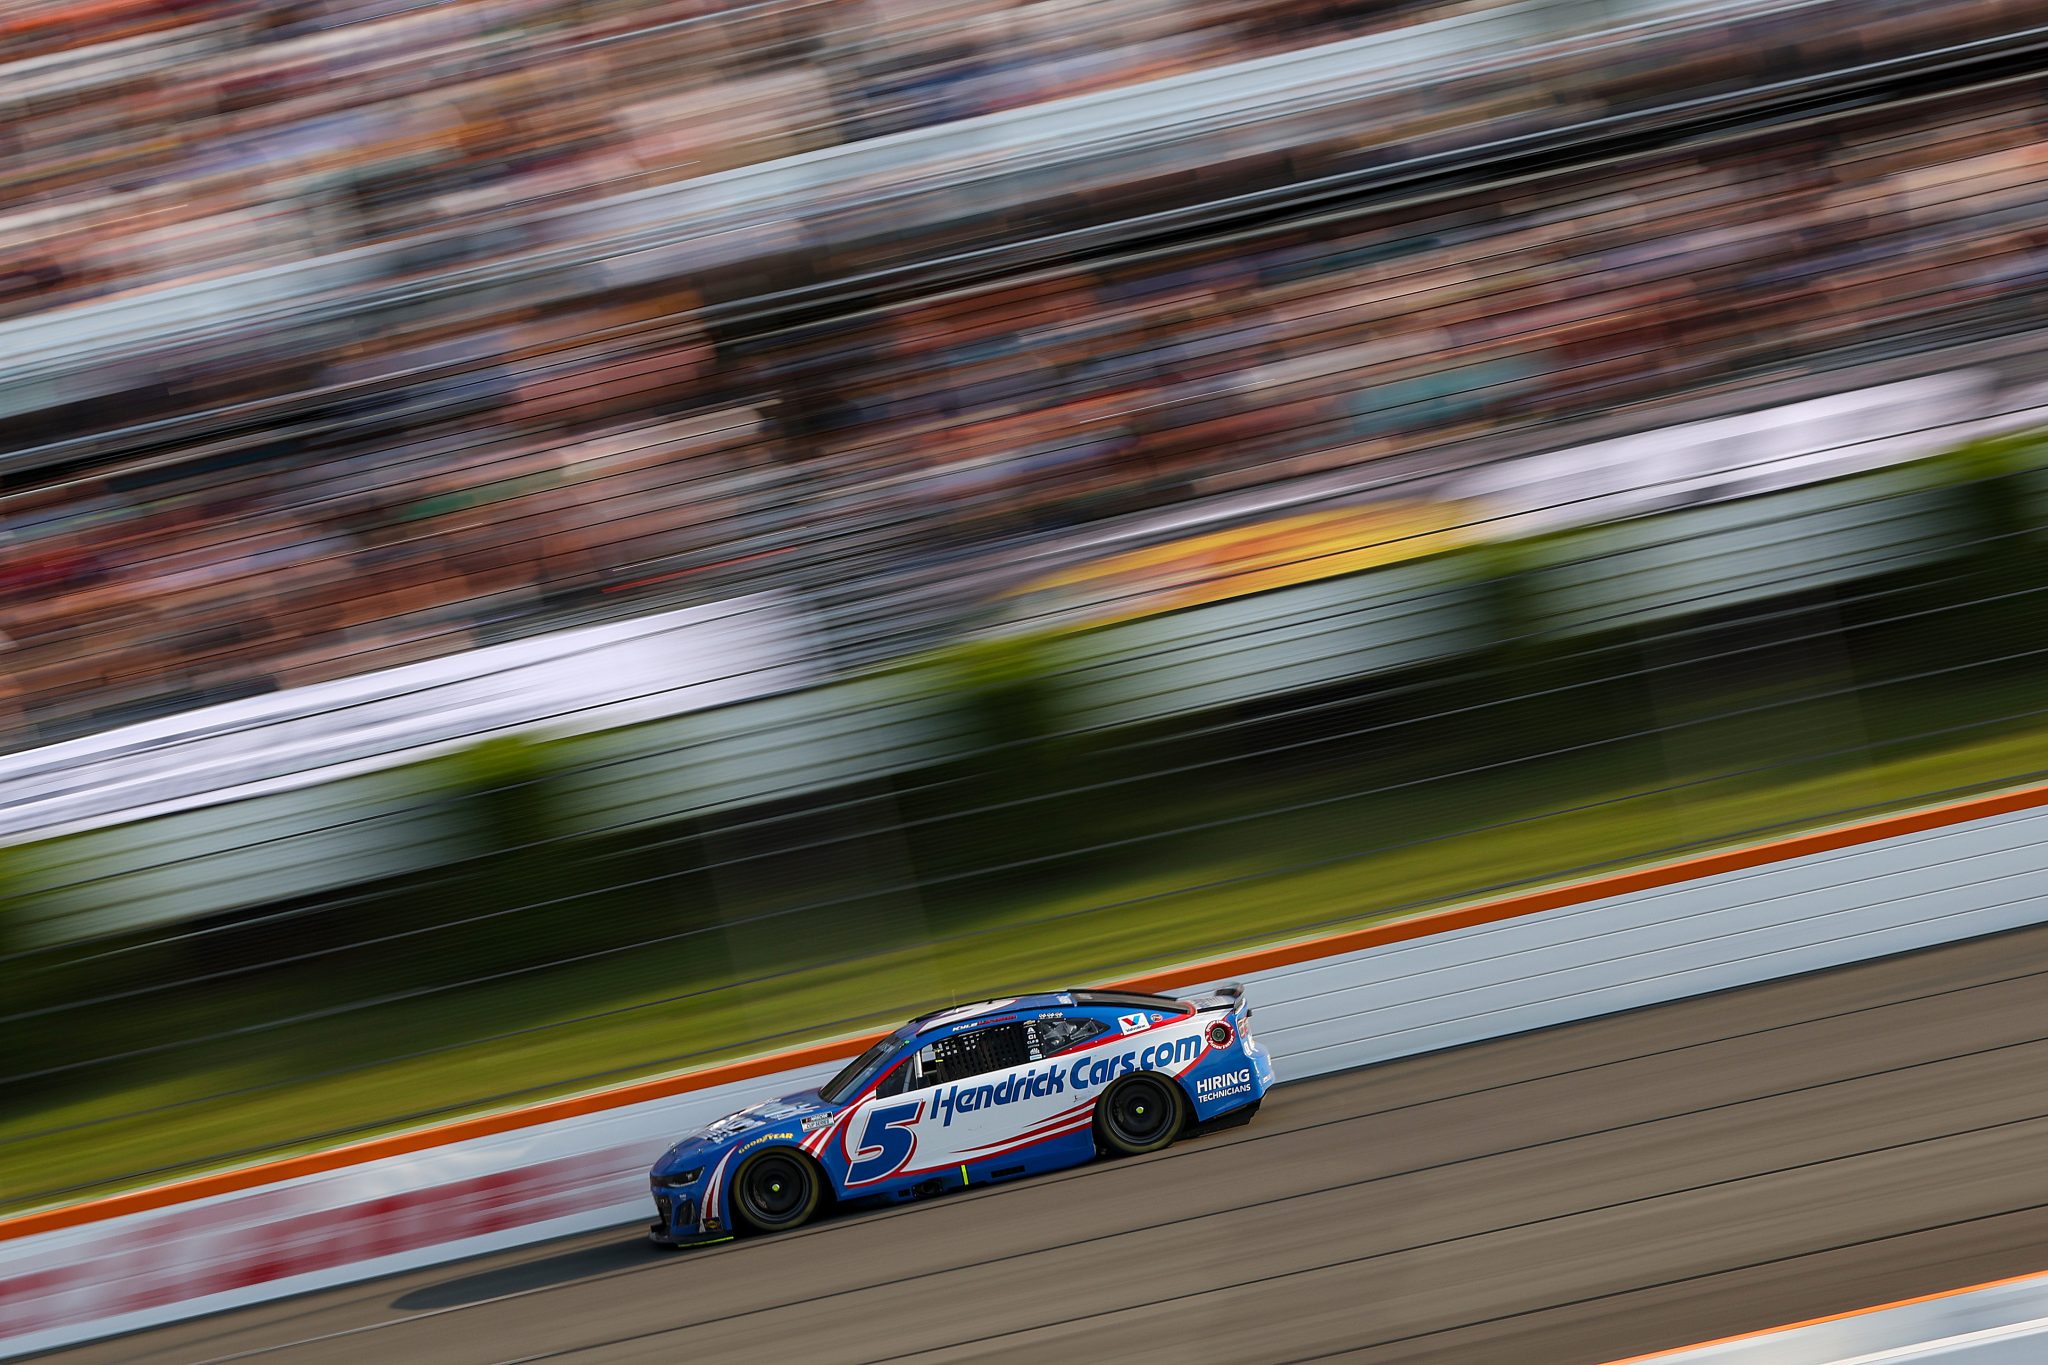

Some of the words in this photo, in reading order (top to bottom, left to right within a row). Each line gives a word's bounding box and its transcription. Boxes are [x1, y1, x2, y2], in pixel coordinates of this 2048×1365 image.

[1196, 1068, 1250, 1094] HIRING
[1198, 1083, 1251, 1103] TECHNICIANS
[738, 1132, 794, 1154] GOODYEAR
[845, 1098, 925, 1189] 5
